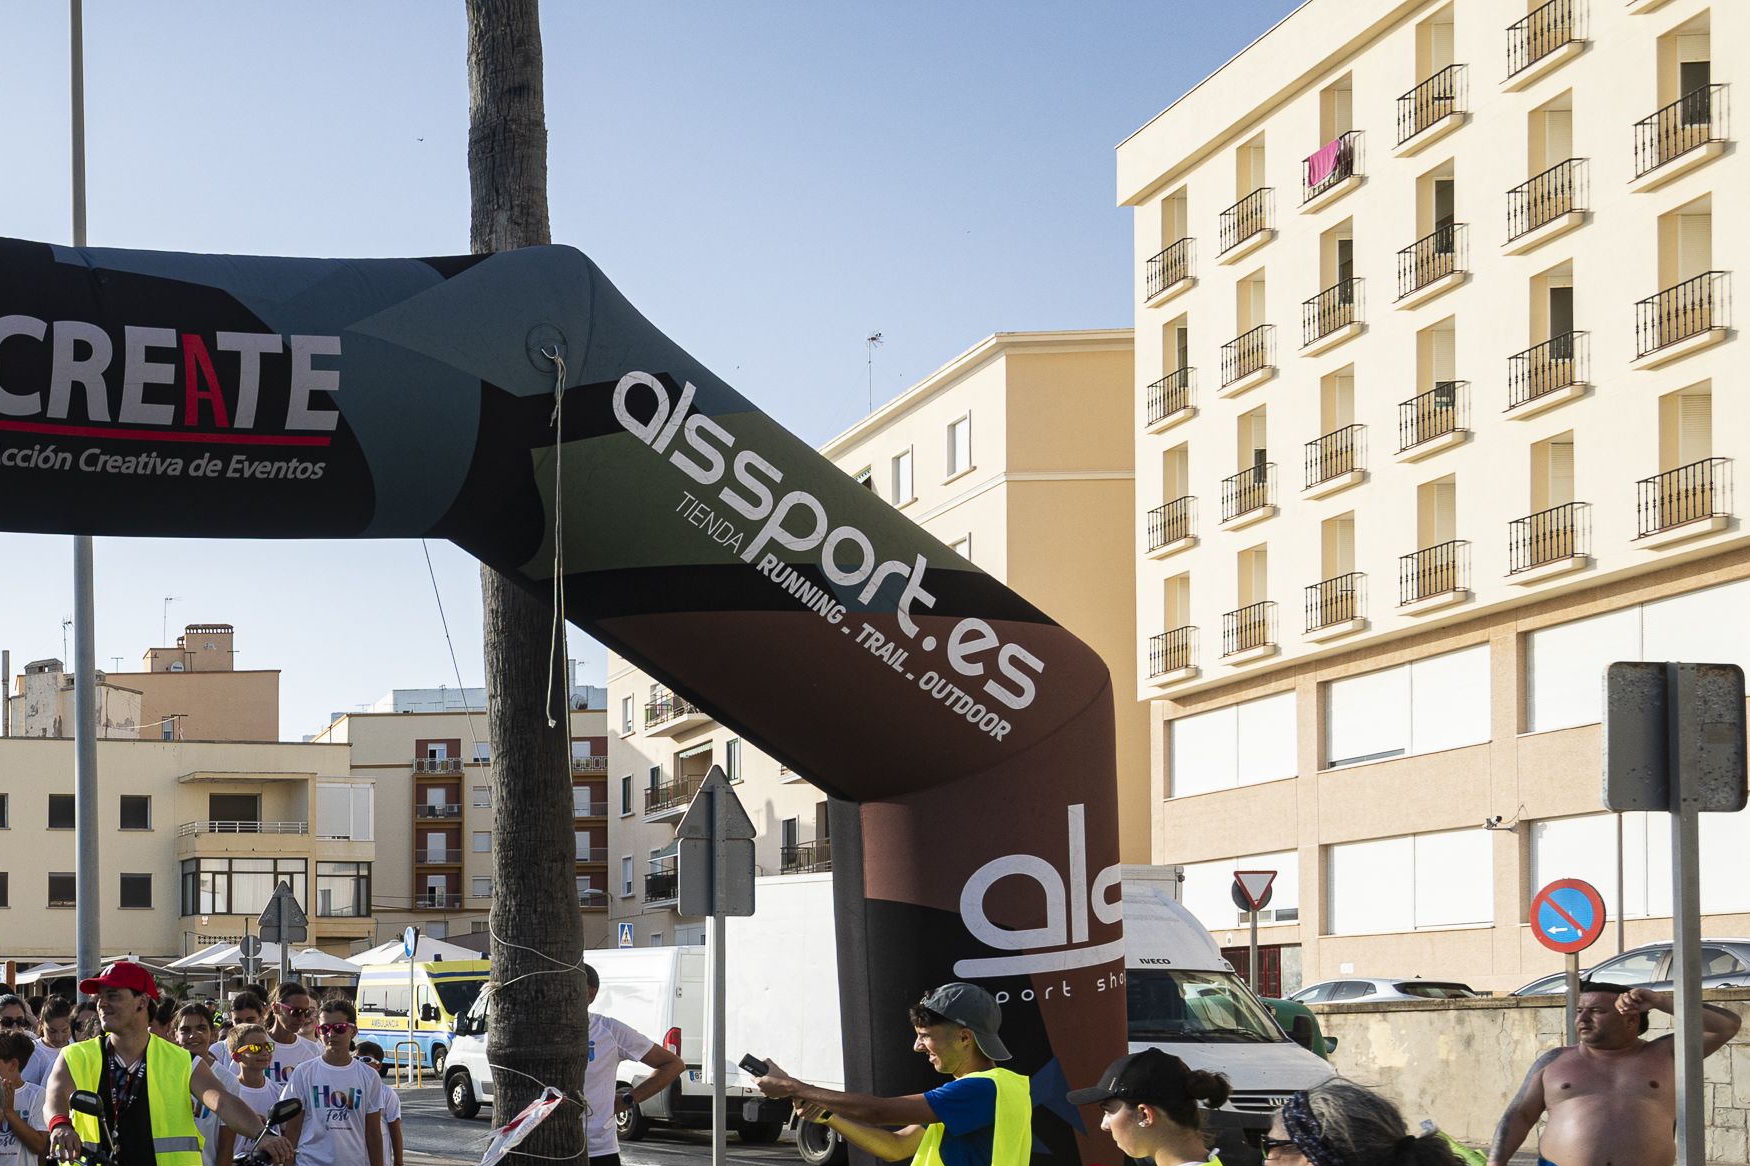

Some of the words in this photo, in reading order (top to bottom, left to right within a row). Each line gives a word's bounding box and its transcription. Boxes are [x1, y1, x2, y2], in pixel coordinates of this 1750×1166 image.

[78, 447, 182, 478] Creativa
[188, 451, 222, 478] de
[226, 454, 325, 481] Eventos
[612, 370, 1046, 711] alssport.es
[675, 490, 746, 555] TIENDA
[756, 552, 847, 625] RUNNING
[855, 622, 912, 673] TRAIL
[919, 671, 1013, 742] OUTDOOR
[1139, 957, 1171, 965] IVECO
[312, 1085, 362, 1110] Holi
[326, 1108, 350, 1122] Fest
